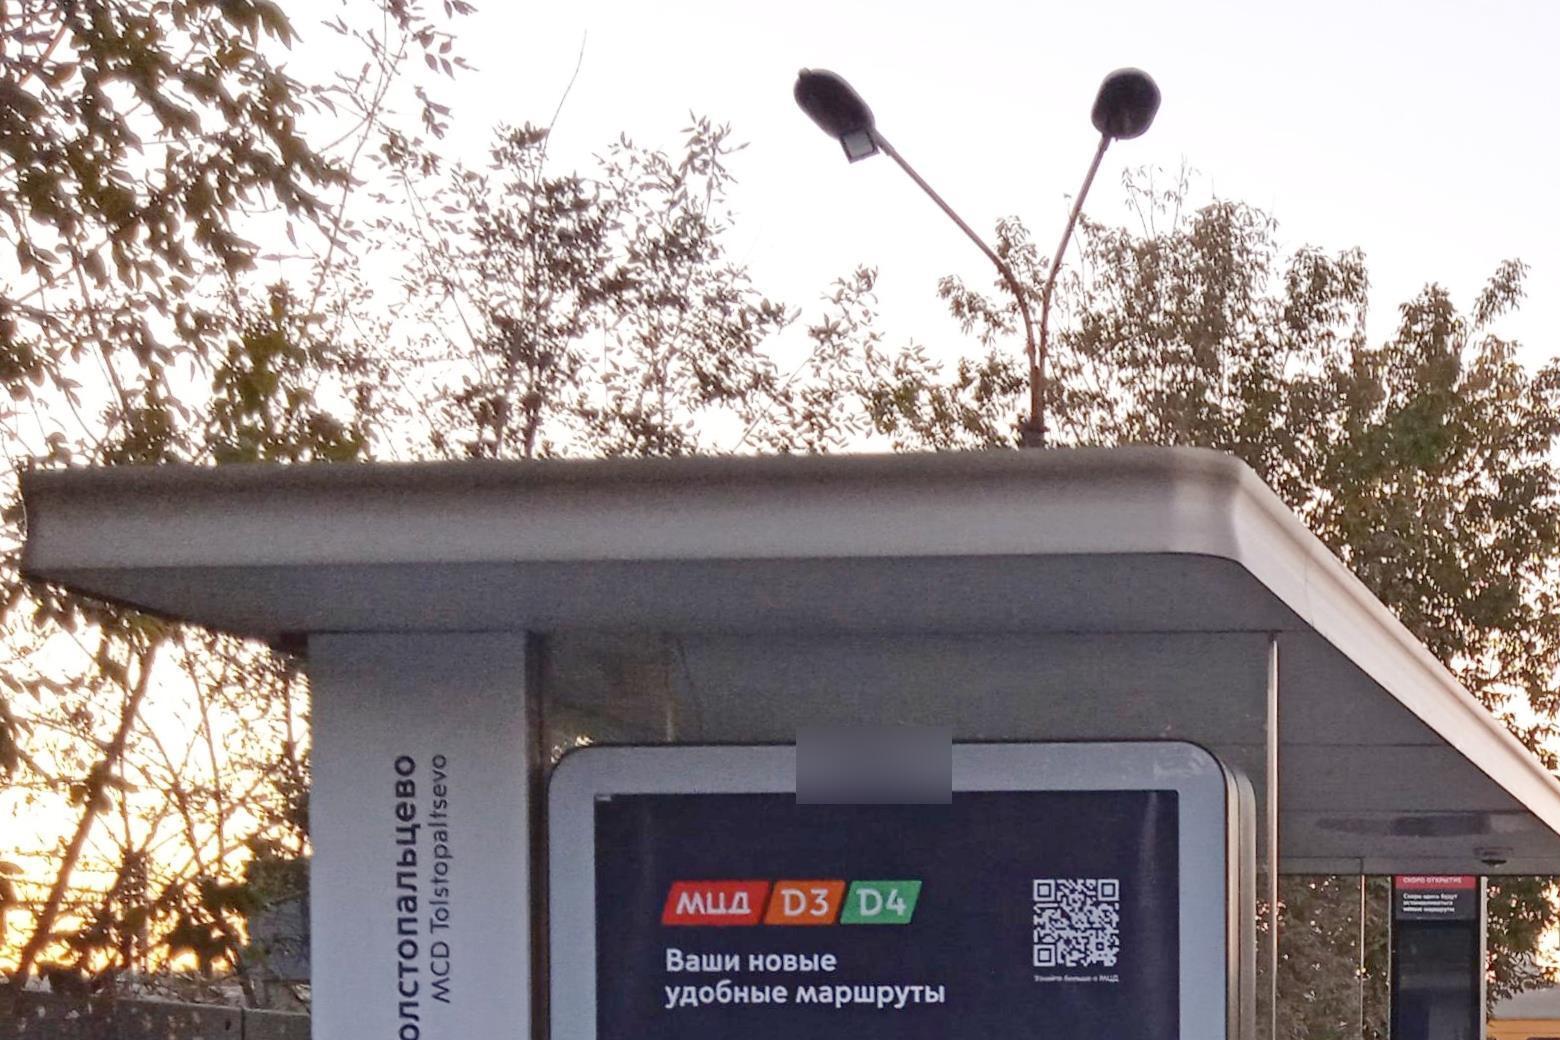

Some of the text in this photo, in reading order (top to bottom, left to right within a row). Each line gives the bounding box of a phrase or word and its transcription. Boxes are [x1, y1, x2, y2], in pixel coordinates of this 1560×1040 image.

[428, 753, 454, 1003] MCD Tolstopaltsevo
[676, 888, 907, 917] МЦД D3 D4
[665, 948, 838, 973] Ваши новые
[665, 980, 946, 1009] удобные маршруты
